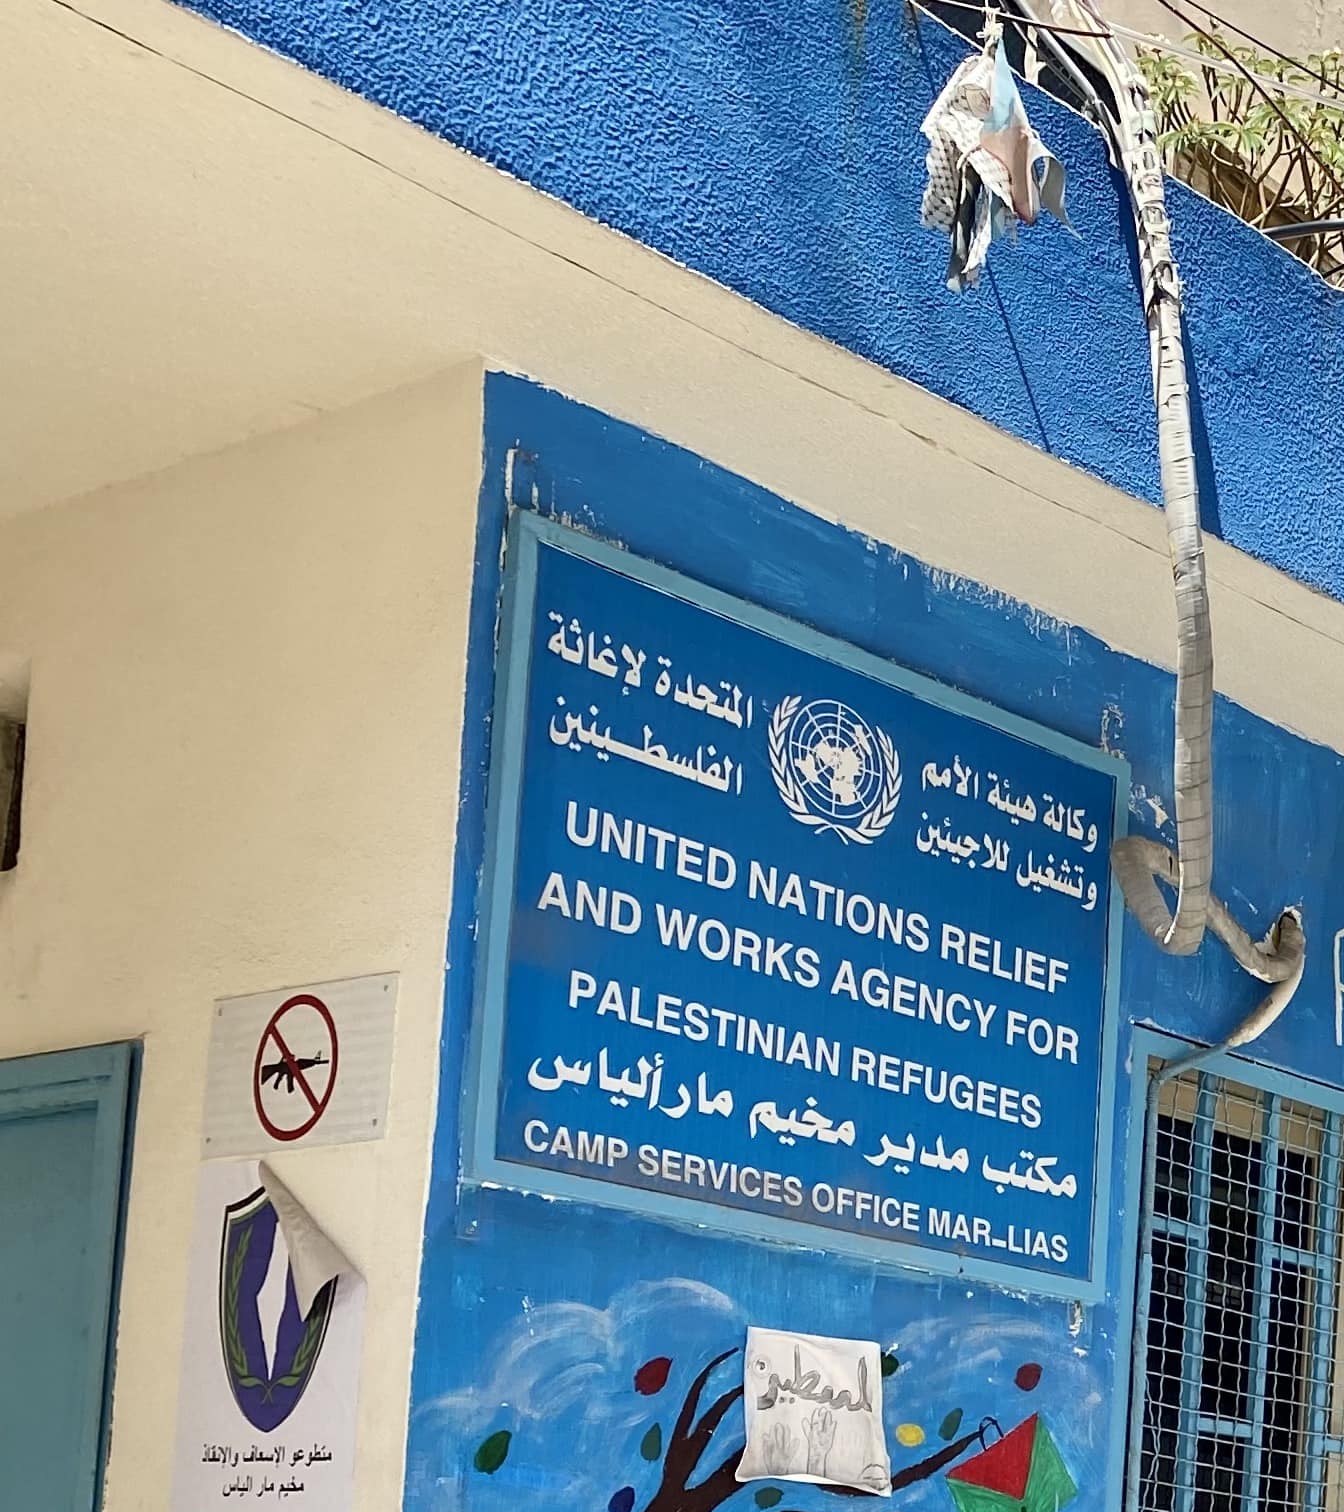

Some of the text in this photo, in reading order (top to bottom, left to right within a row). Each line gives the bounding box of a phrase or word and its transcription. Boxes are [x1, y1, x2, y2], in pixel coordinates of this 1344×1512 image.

[548, 610, 1098, 853] وكالة هيئة الأمم المتحدة لإغاثة
[566, 801, 1070, 994] UNITED NATIONS RELIEF
[1016, 850, 1098, 911] وتشغيل
[537, 871, 1080, 1064] AND WORKS AGENCY FOR
[568, 970, 1042, 1129] PALESTINIAN REFUGEES
[748, 1095, 857, 1148] مخيم
[863, 1130, 969, 1178] مدير
[981, 1149, 1078, 1200] مكتب
[523, 1120, 1069, 1263] CAMP SERVICES OFFICE MAR-LIAS
[289, 1443, 333, 1467] متطوعو
[256, 1476, 275, 1497] مار
[278, 1475, 305, 1500] مخيم
